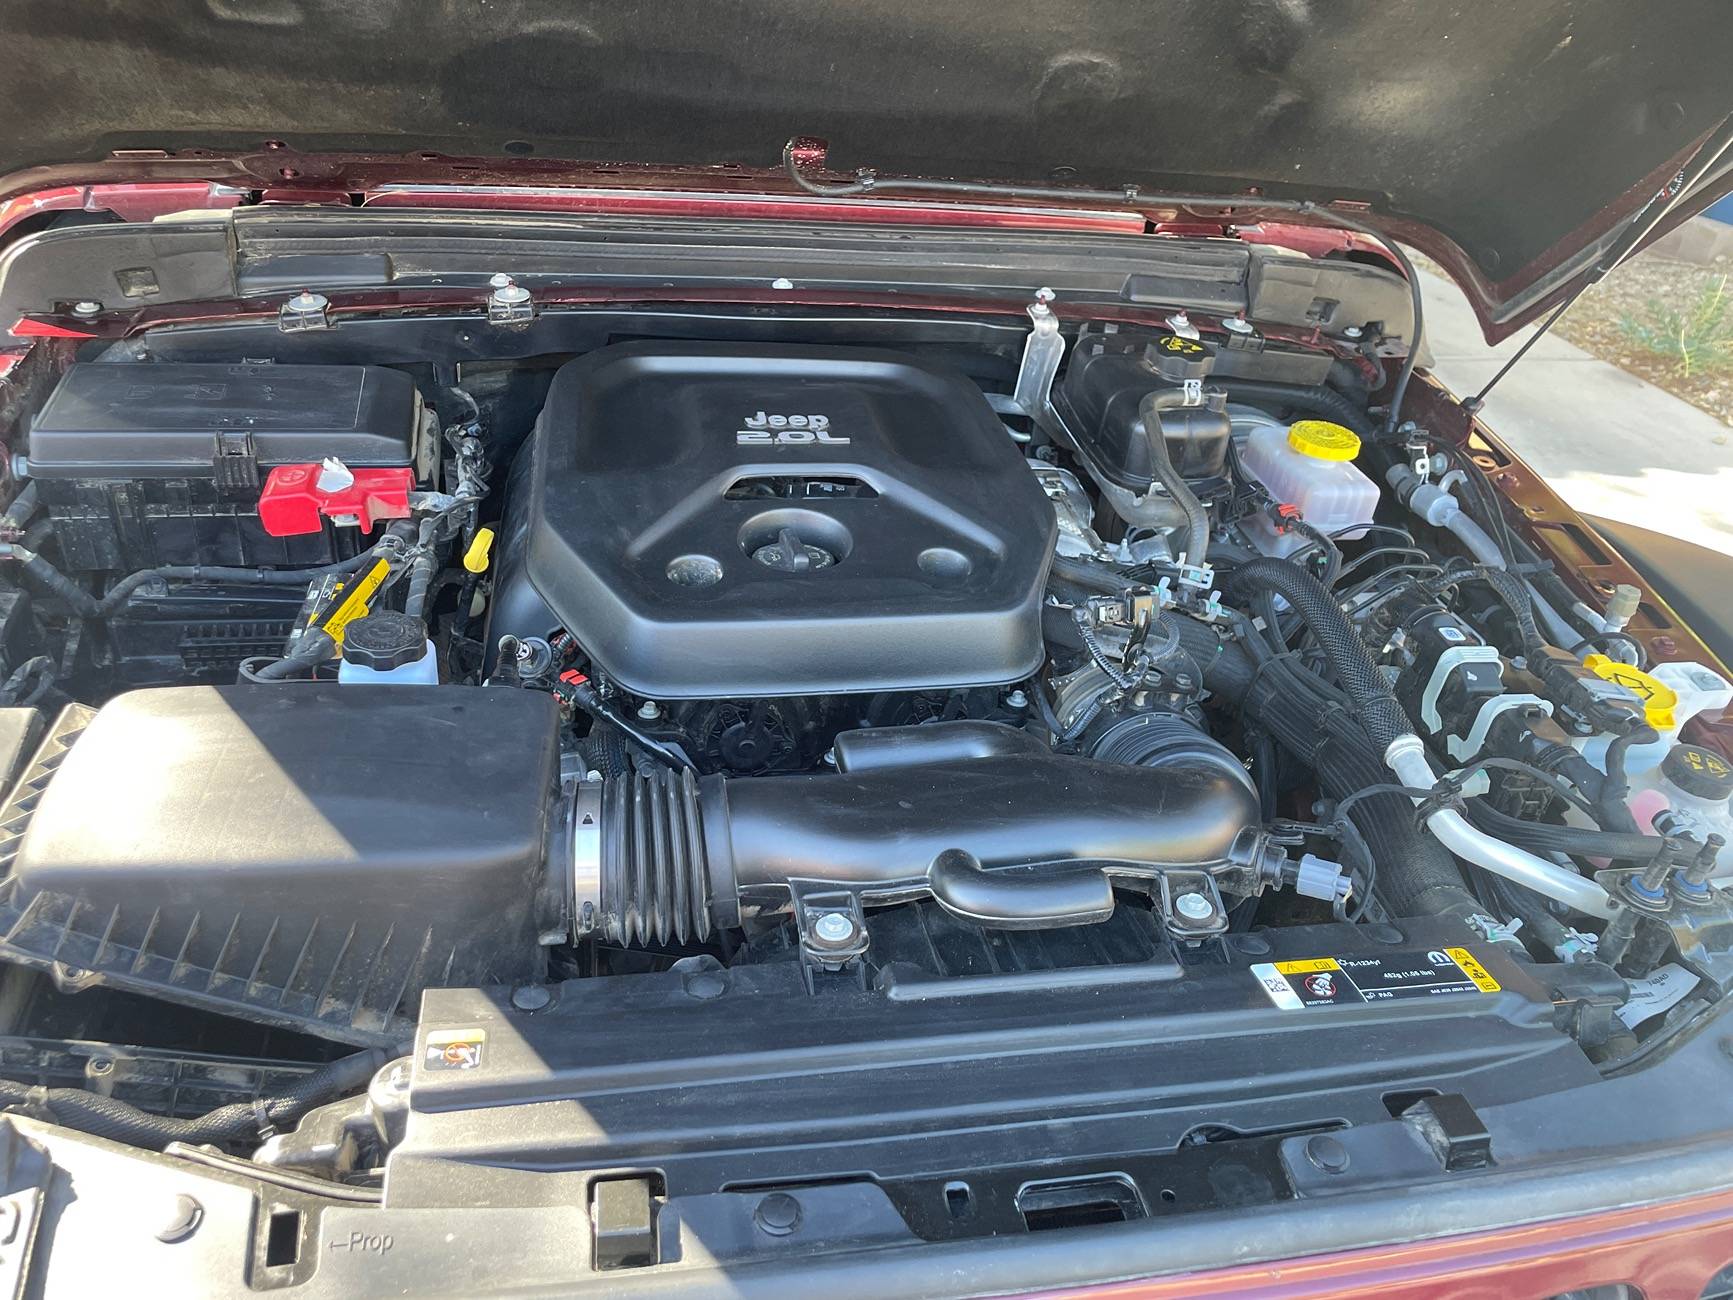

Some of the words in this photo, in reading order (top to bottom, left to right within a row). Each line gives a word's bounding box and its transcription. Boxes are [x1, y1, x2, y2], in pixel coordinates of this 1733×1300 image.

[744, 411, 829, 431] Jeep
[736, 430, 850, 444] 2.0L
[349, 1231, 394, 1255] Prop
